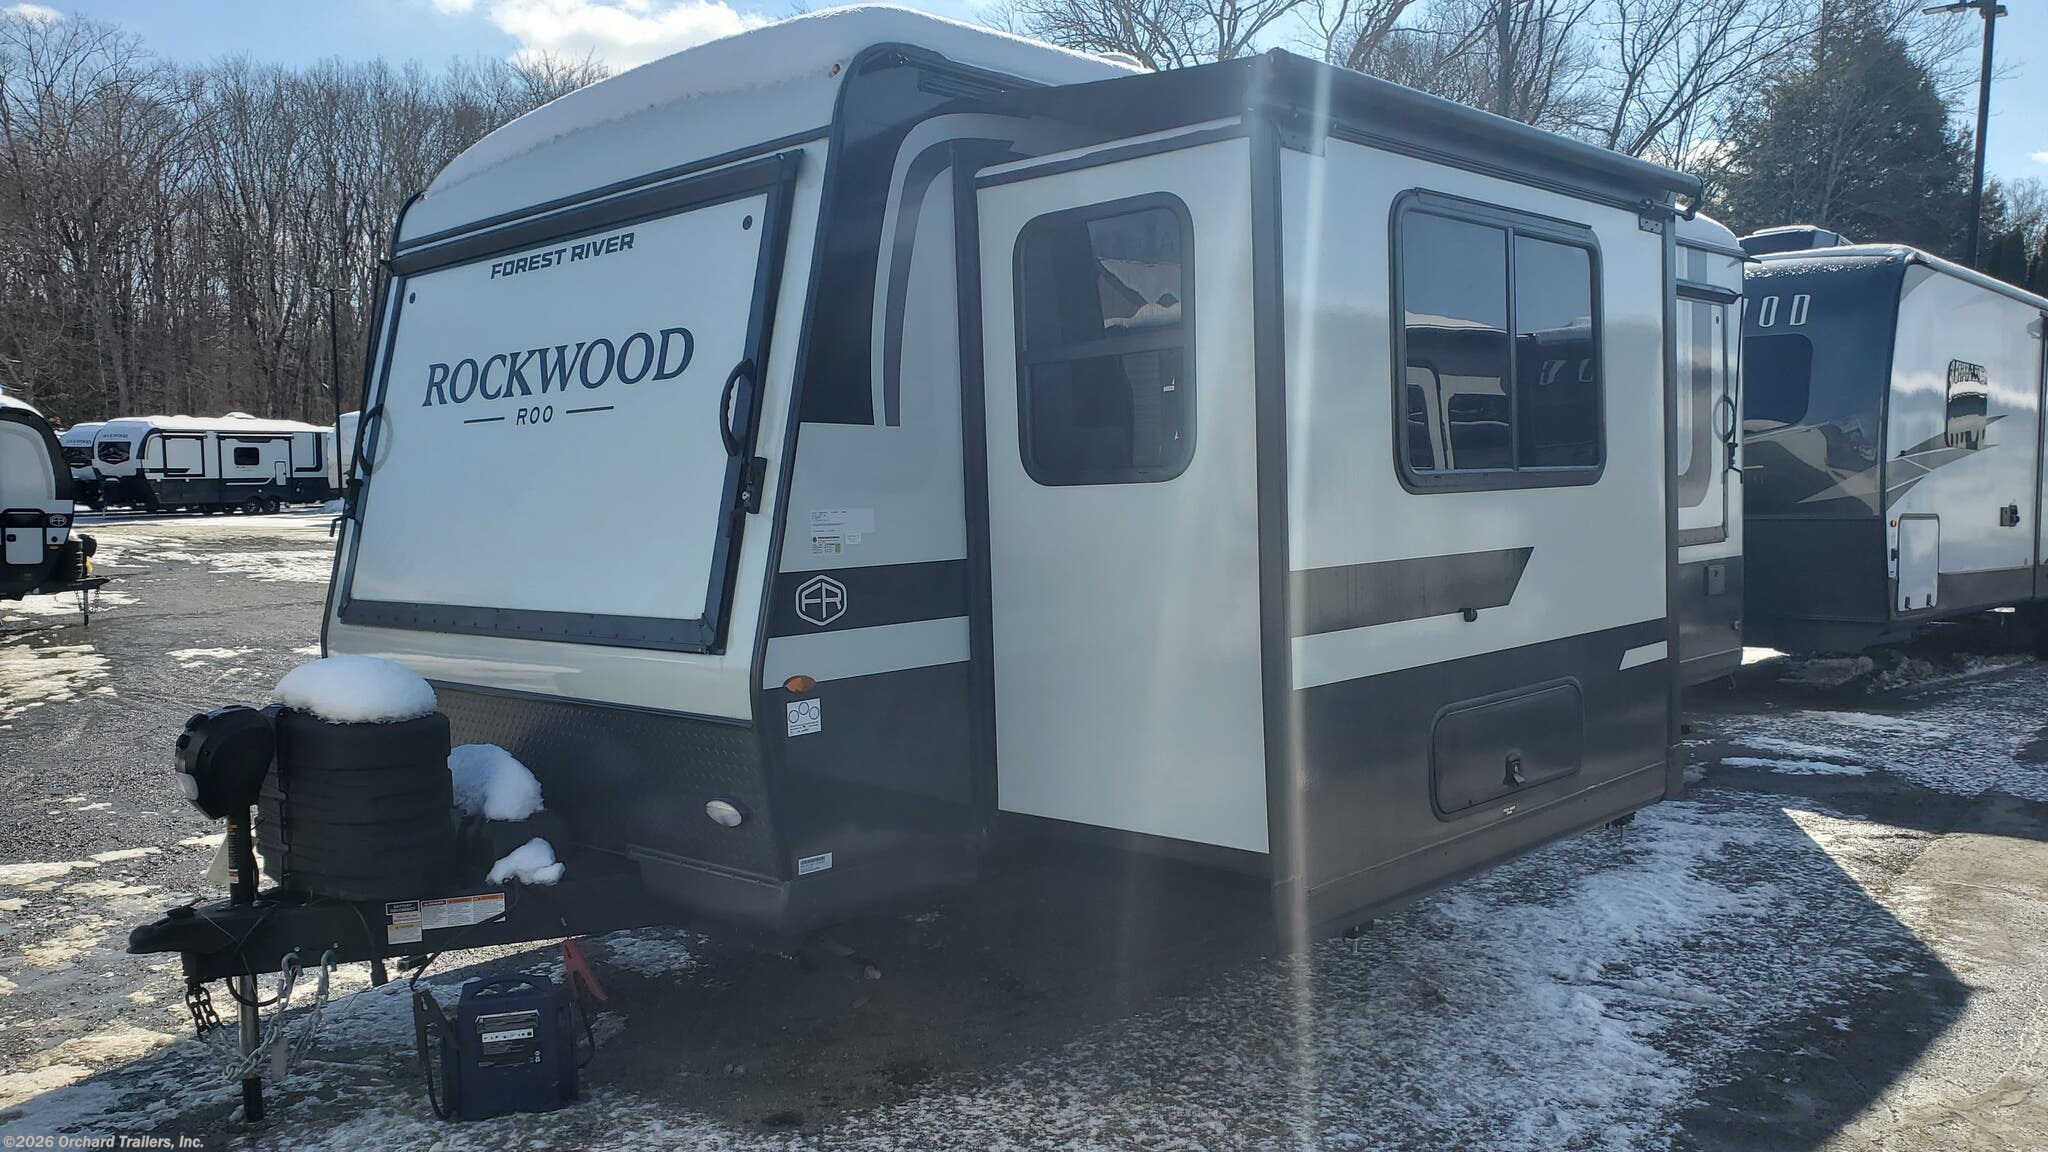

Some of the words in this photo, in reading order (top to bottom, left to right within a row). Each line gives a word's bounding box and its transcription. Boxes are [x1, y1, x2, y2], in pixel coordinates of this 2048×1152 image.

[490, 248, 567, 280] FOREST
[570, 232, 635, 262] RIVER
[1743, 294, 1811, 328] OD
[422, 327, 695, 407] ROCKWOOD
[516, 405, 553, 426] ROO
